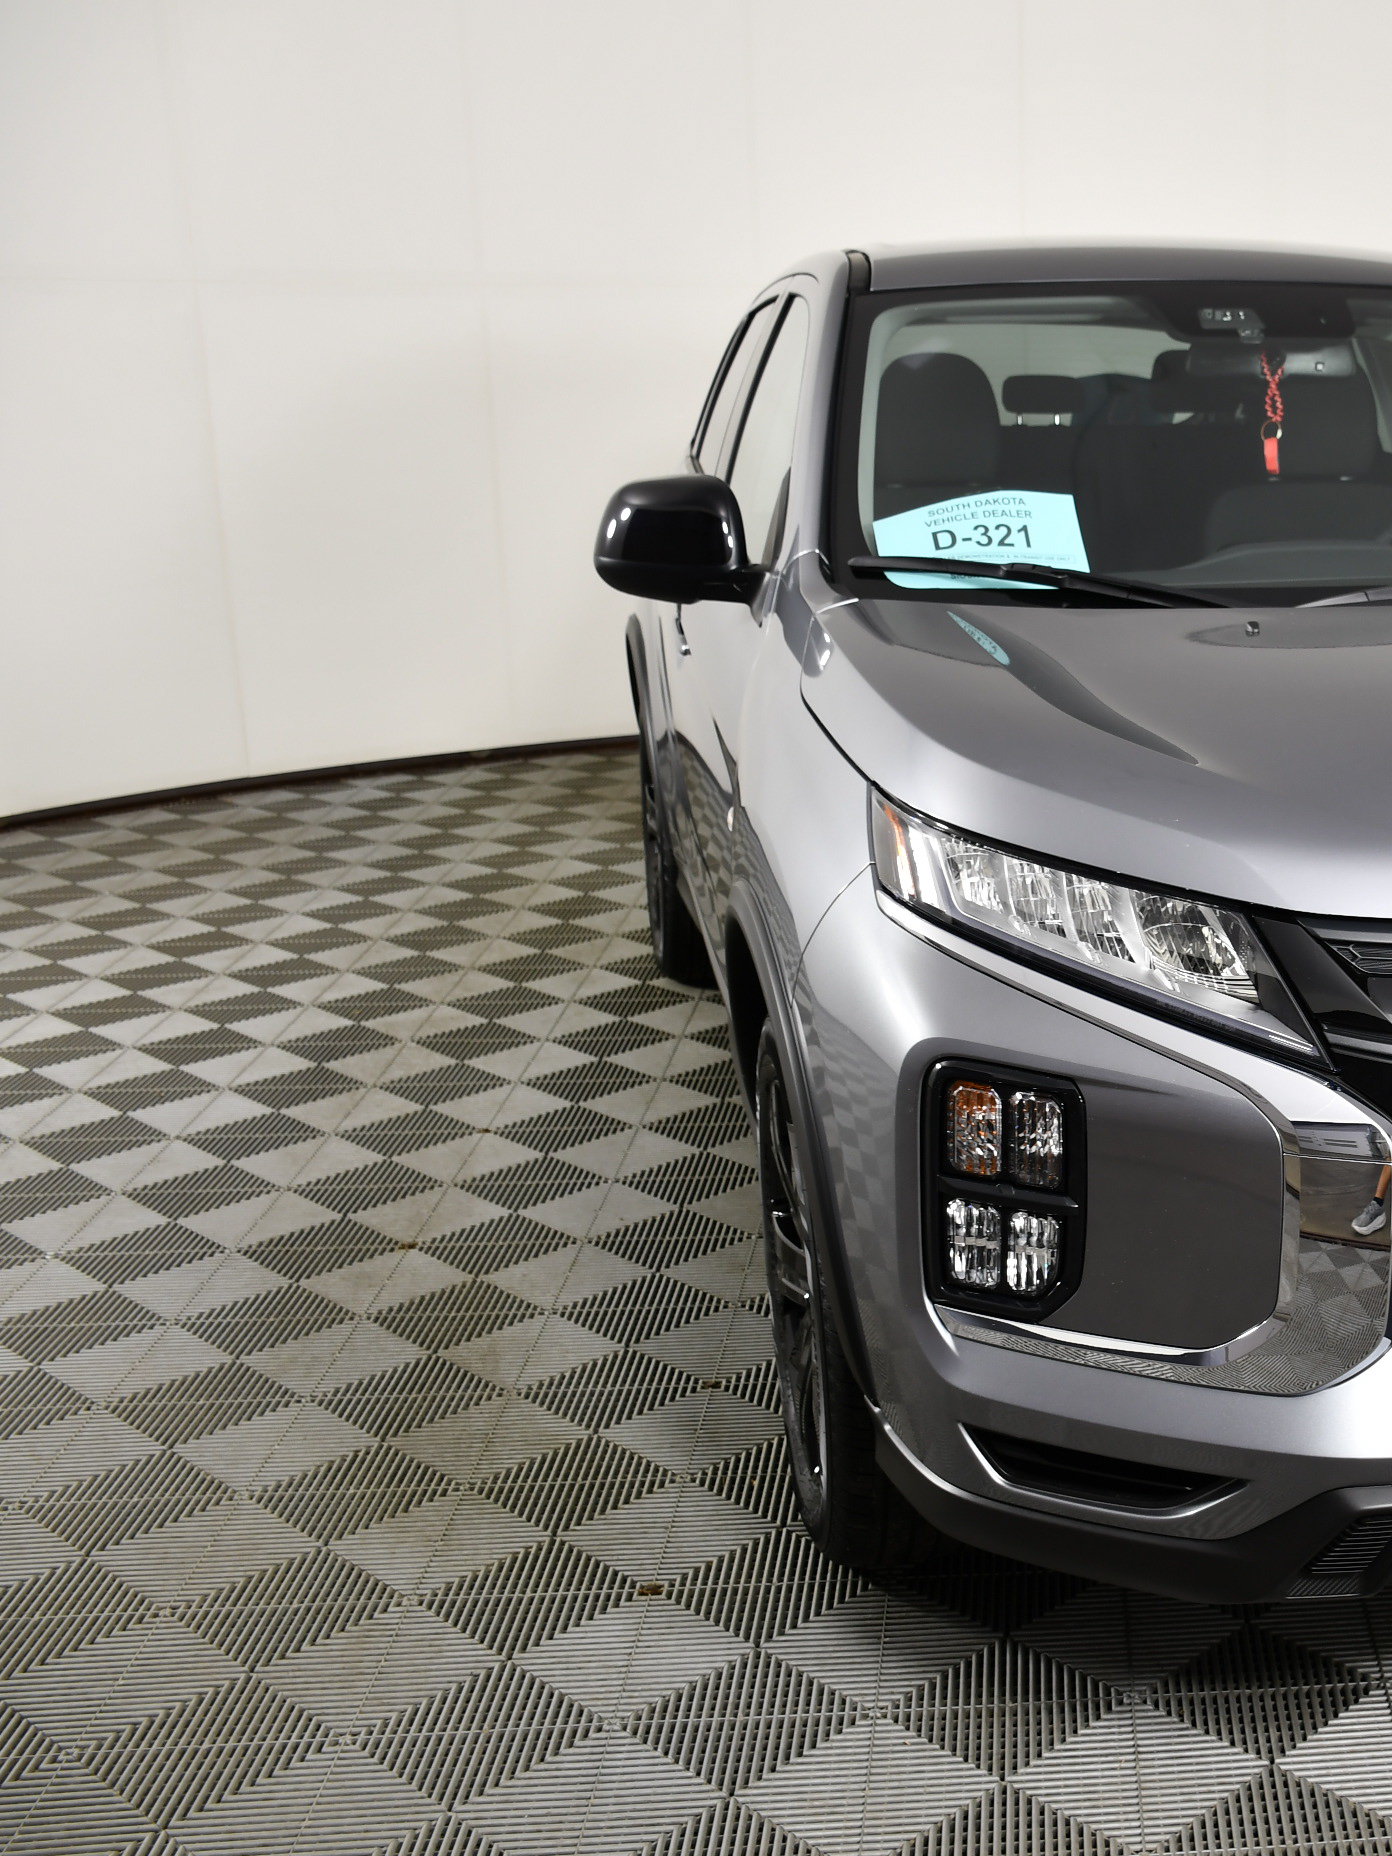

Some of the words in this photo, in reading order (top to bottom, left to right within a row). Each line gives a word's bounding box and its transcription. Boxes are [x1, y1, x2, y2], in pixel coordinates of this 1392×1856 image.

[928, 502, 971, 517] SOUTH
[974, 498, 1026, 508] DAKOTA
[925, 511, 979, 527] VEHICLE
[982, 509, 1033, 519] DEALER
[931, 523, 1032, 551] D-321
